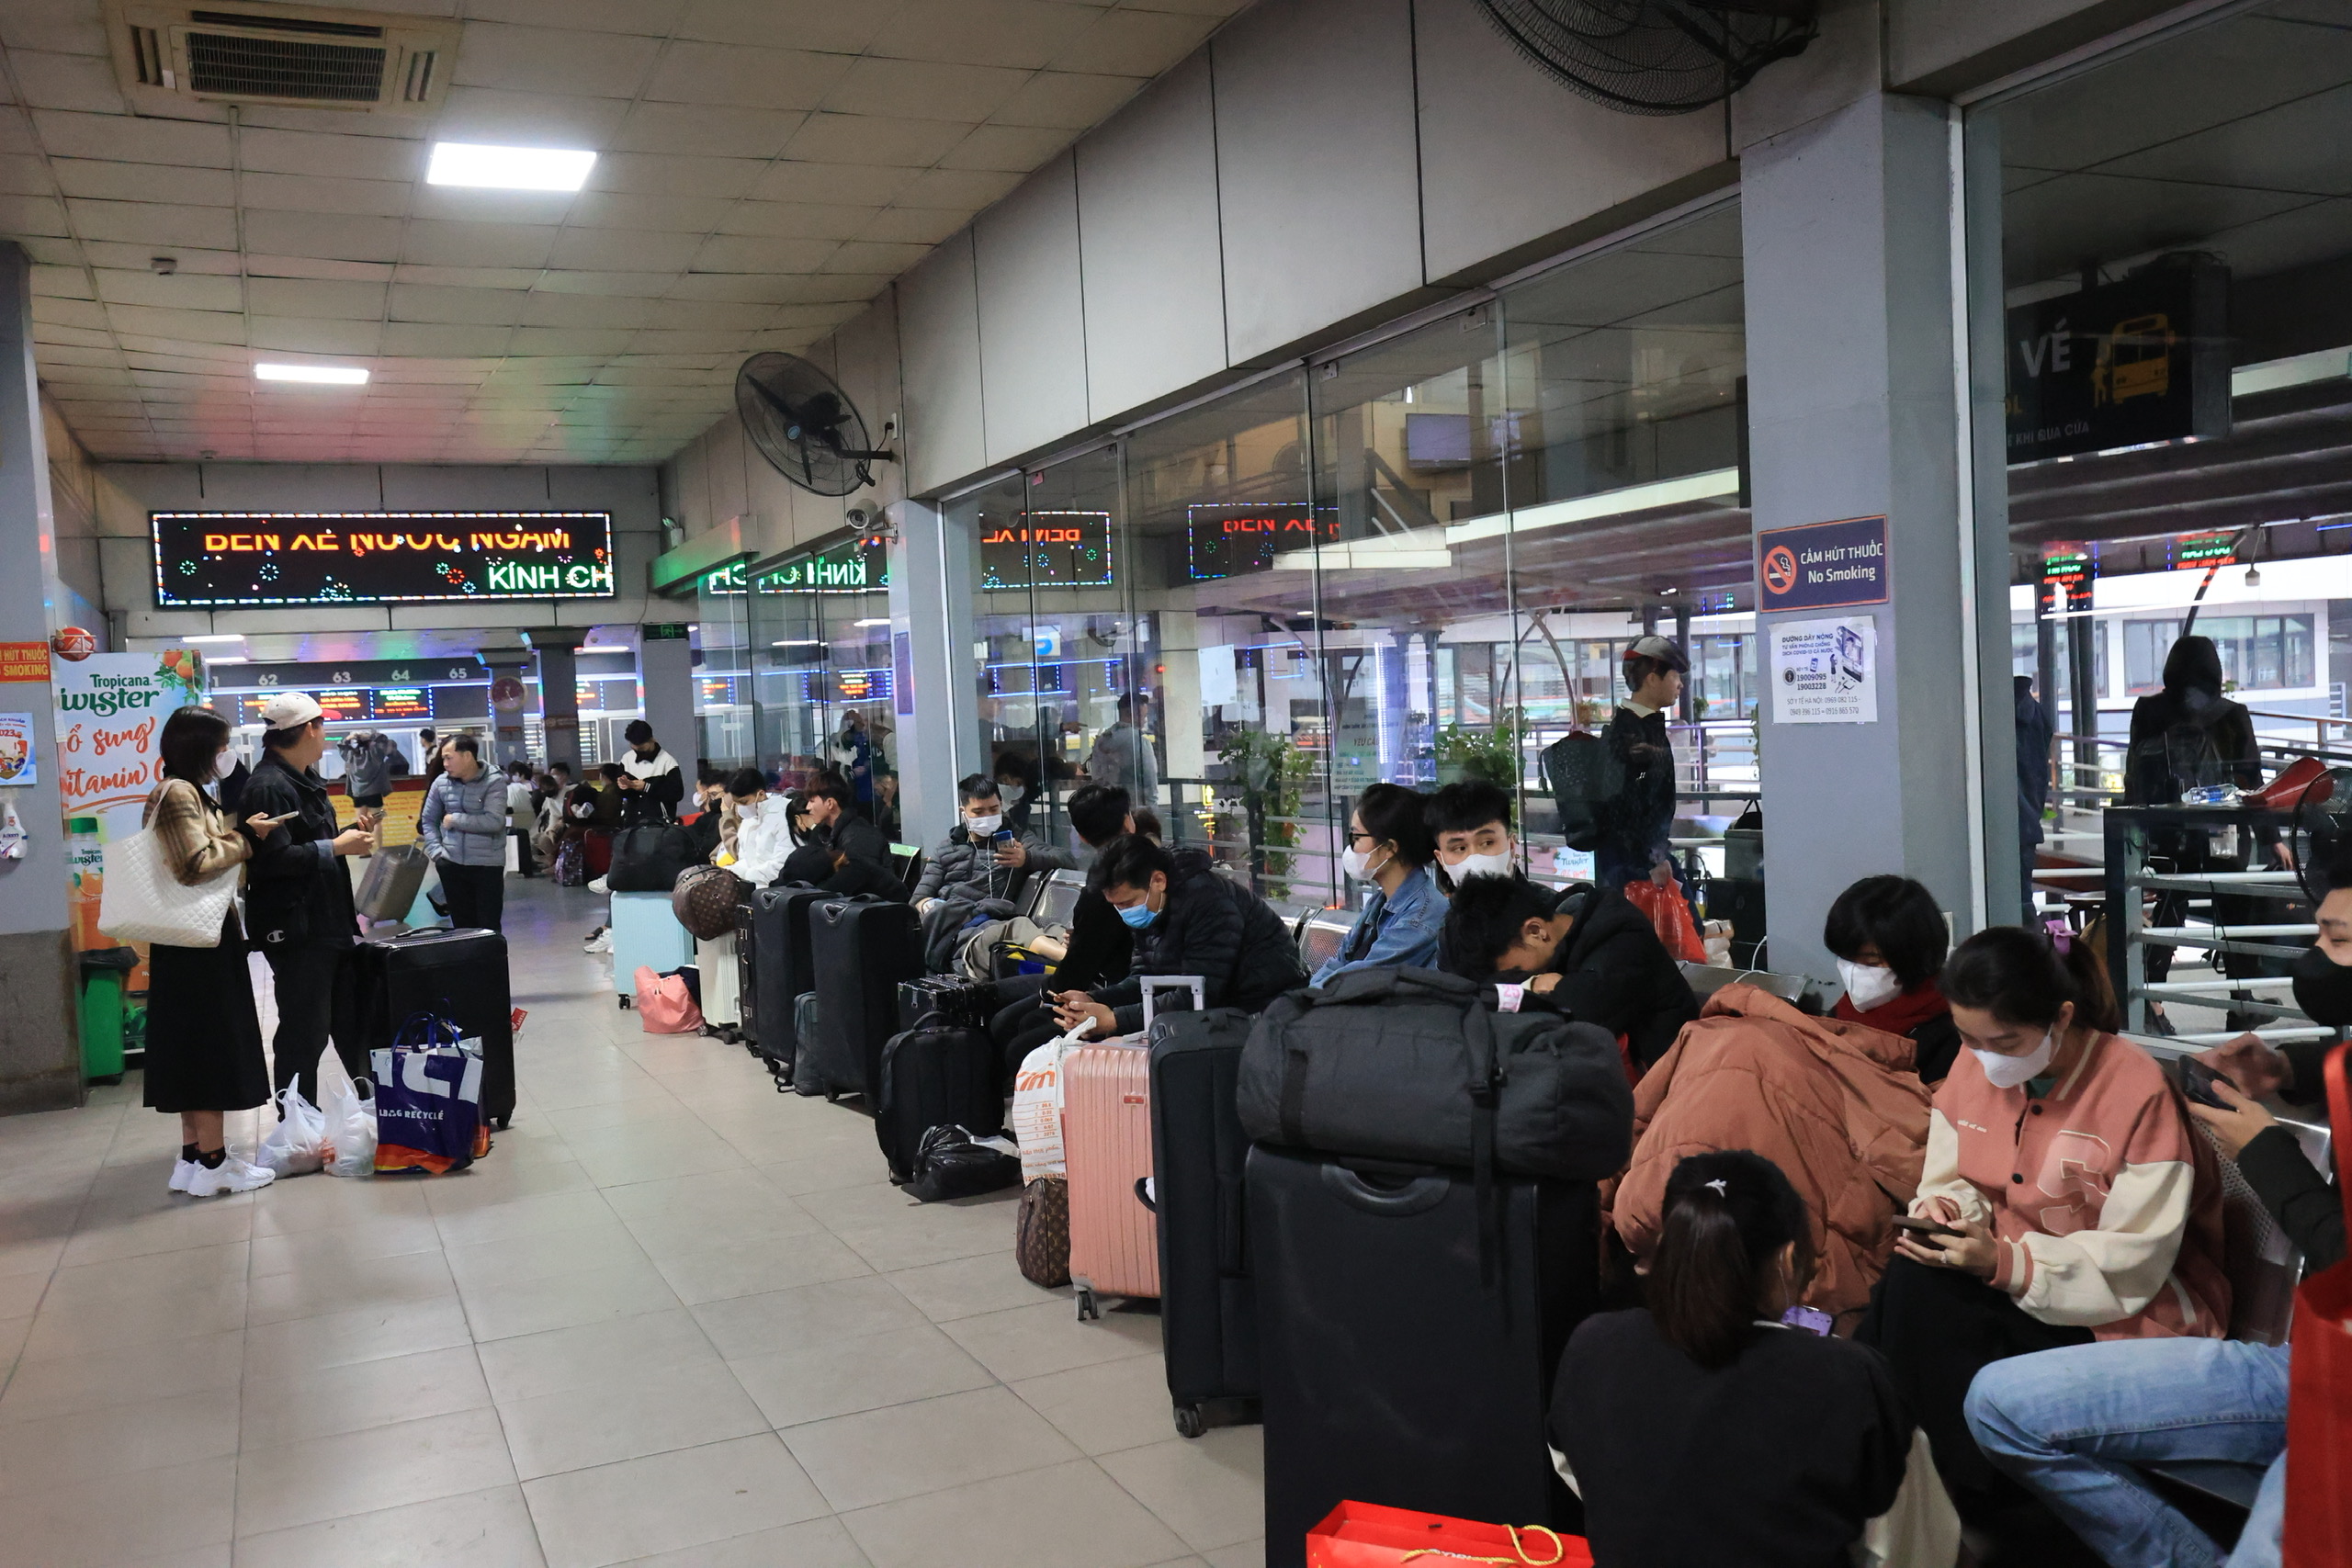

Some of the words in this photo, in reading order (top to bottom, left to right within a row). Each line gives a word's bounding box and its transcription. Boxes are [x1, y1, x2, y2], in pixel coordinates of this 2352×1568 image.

[2020, 317, 2071, 378] VÉ
[1801, 547, 1823, 565] CẤM
[1825, 546, 1846, 562] HÚT
[1848, 539, 1883, 559] THUỐC
[488, 561, 560, 590] KÍNH
[1808, 570, 1824, 584] No
[1826, 565, 1876, 581] Smoking
[21, 644, 48, 660] THUỐC
[3, 664, 49, 677] SMOKING
[332, 671, 352, 683] 63
[391, 670, 411, 682] 64
[449, 668, 468, 680] 65
[89, 673, 151, 689] Tropicana
[258, 673, 278, 686] 62
[1796, 673, 1827, 682] 19009095
[1797, 682, 1827, 691] 19003228
[93, 716, 155, 755] sung
[404, 1110, 444, 1121] RECYCLÉ
